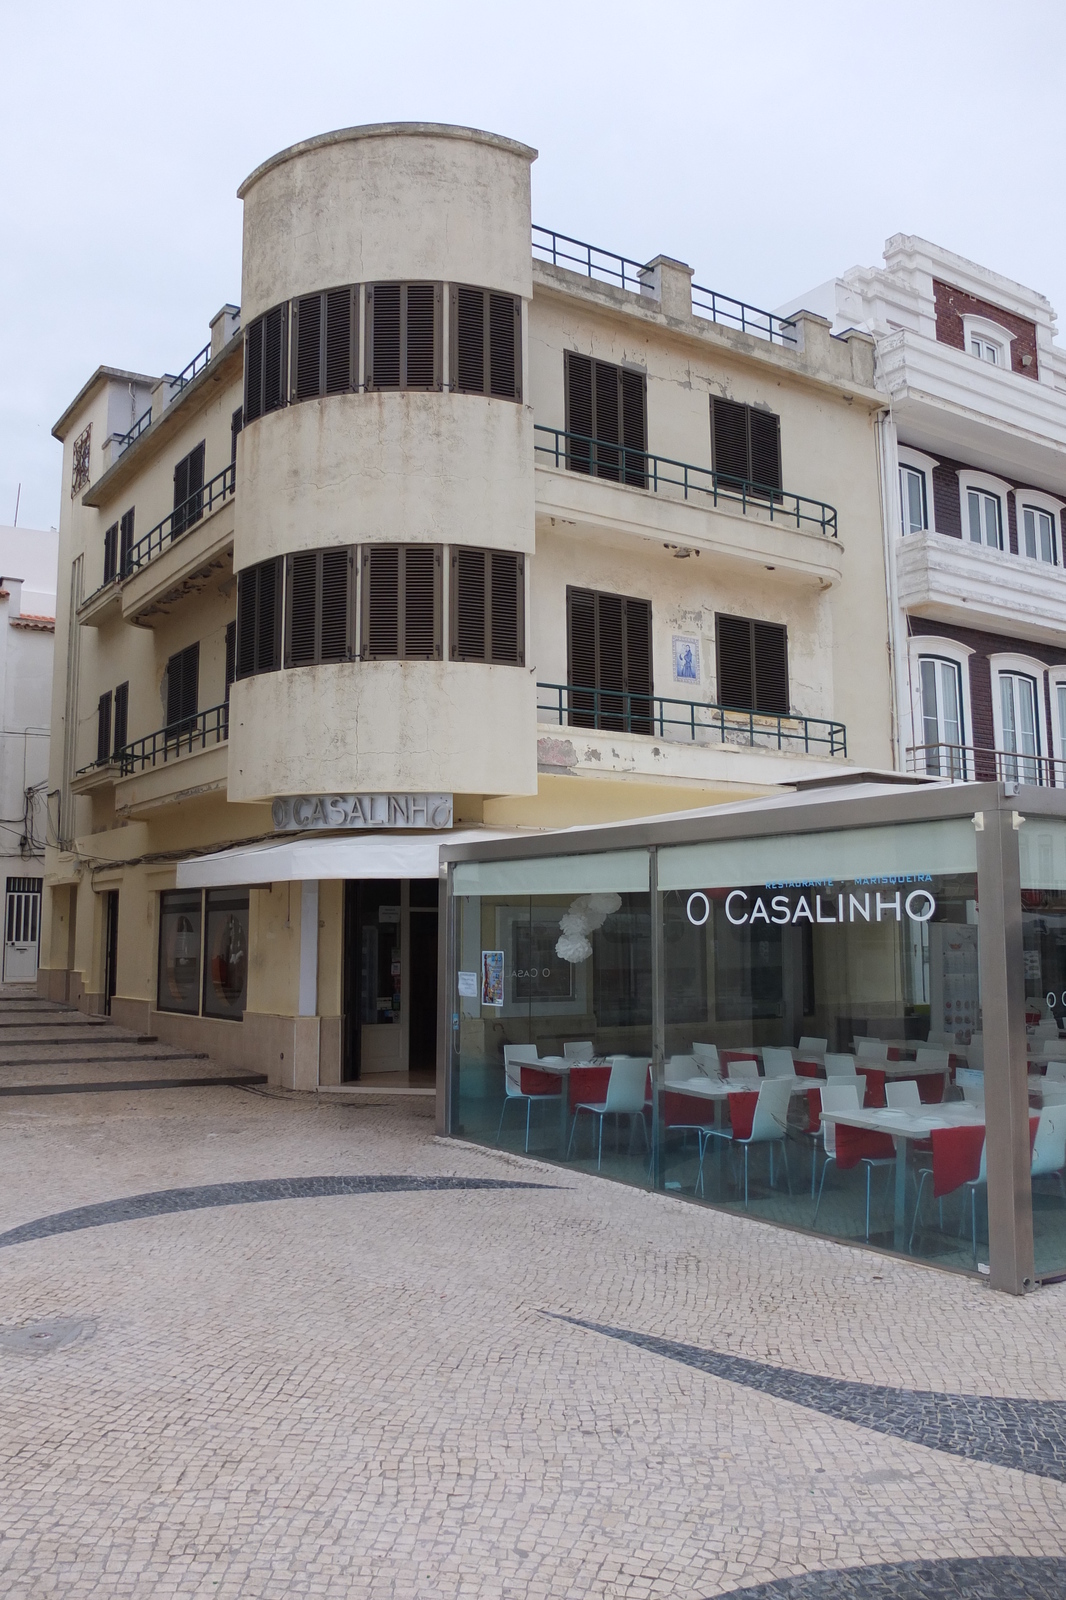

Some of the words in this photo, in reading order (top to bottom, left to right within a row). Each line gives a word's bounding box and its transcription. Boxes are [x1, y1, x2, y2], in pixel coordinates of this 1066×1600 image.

[272, 797, 287, 828] O
[293, 795, 452, 830] CASALINHO
[765, 878, 834, 890] RESTAURANTE
[854, 873, 932, 885] MARISQUEIRA
[686, 891, 710, 926] O
